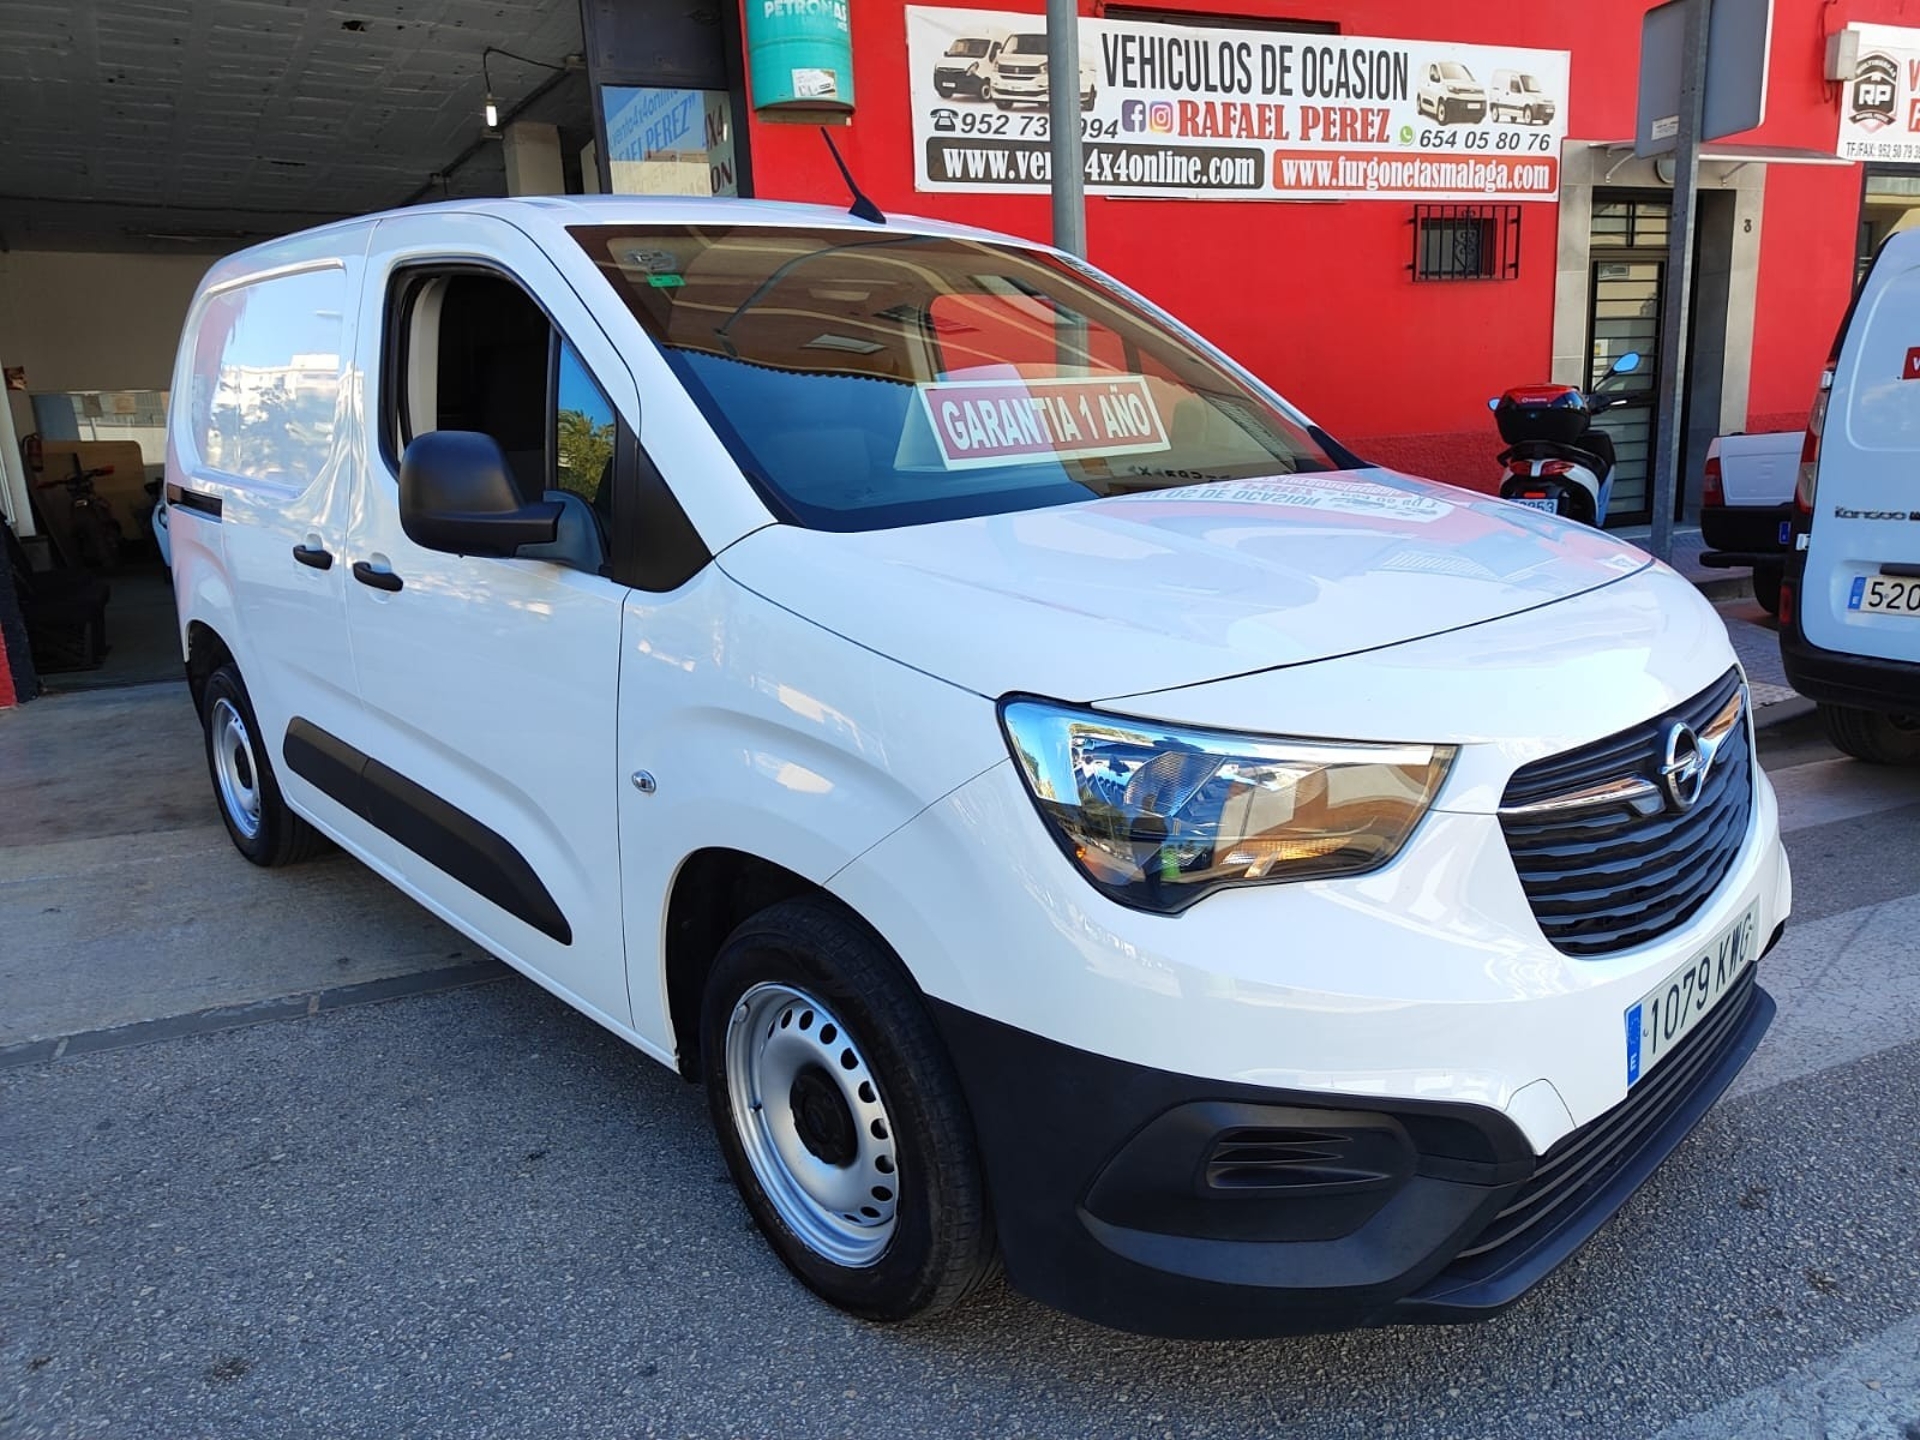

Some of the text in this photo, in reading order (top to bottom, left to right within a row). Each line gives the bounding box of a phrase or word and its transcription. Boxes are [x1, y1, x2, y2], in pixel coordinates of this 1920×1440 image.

[1101, 33, 1408, 101] VEHICULOS DE OCASION
[960, 112, 1010, 135] 952
[1177, 99, 1390, 143] RAFAEL PEREZ
[1419, 129, 1551, 151] 654 05 80 76
[942, 148, 1255, 185] www.ve4x4online.com
[1281, 150, 1550, 192] www.furgonetasmalaga.com
[942, 384, 1152, 450] GARANTIA 1 AÑO
[1650, 955, 1711, 1055] 1079
